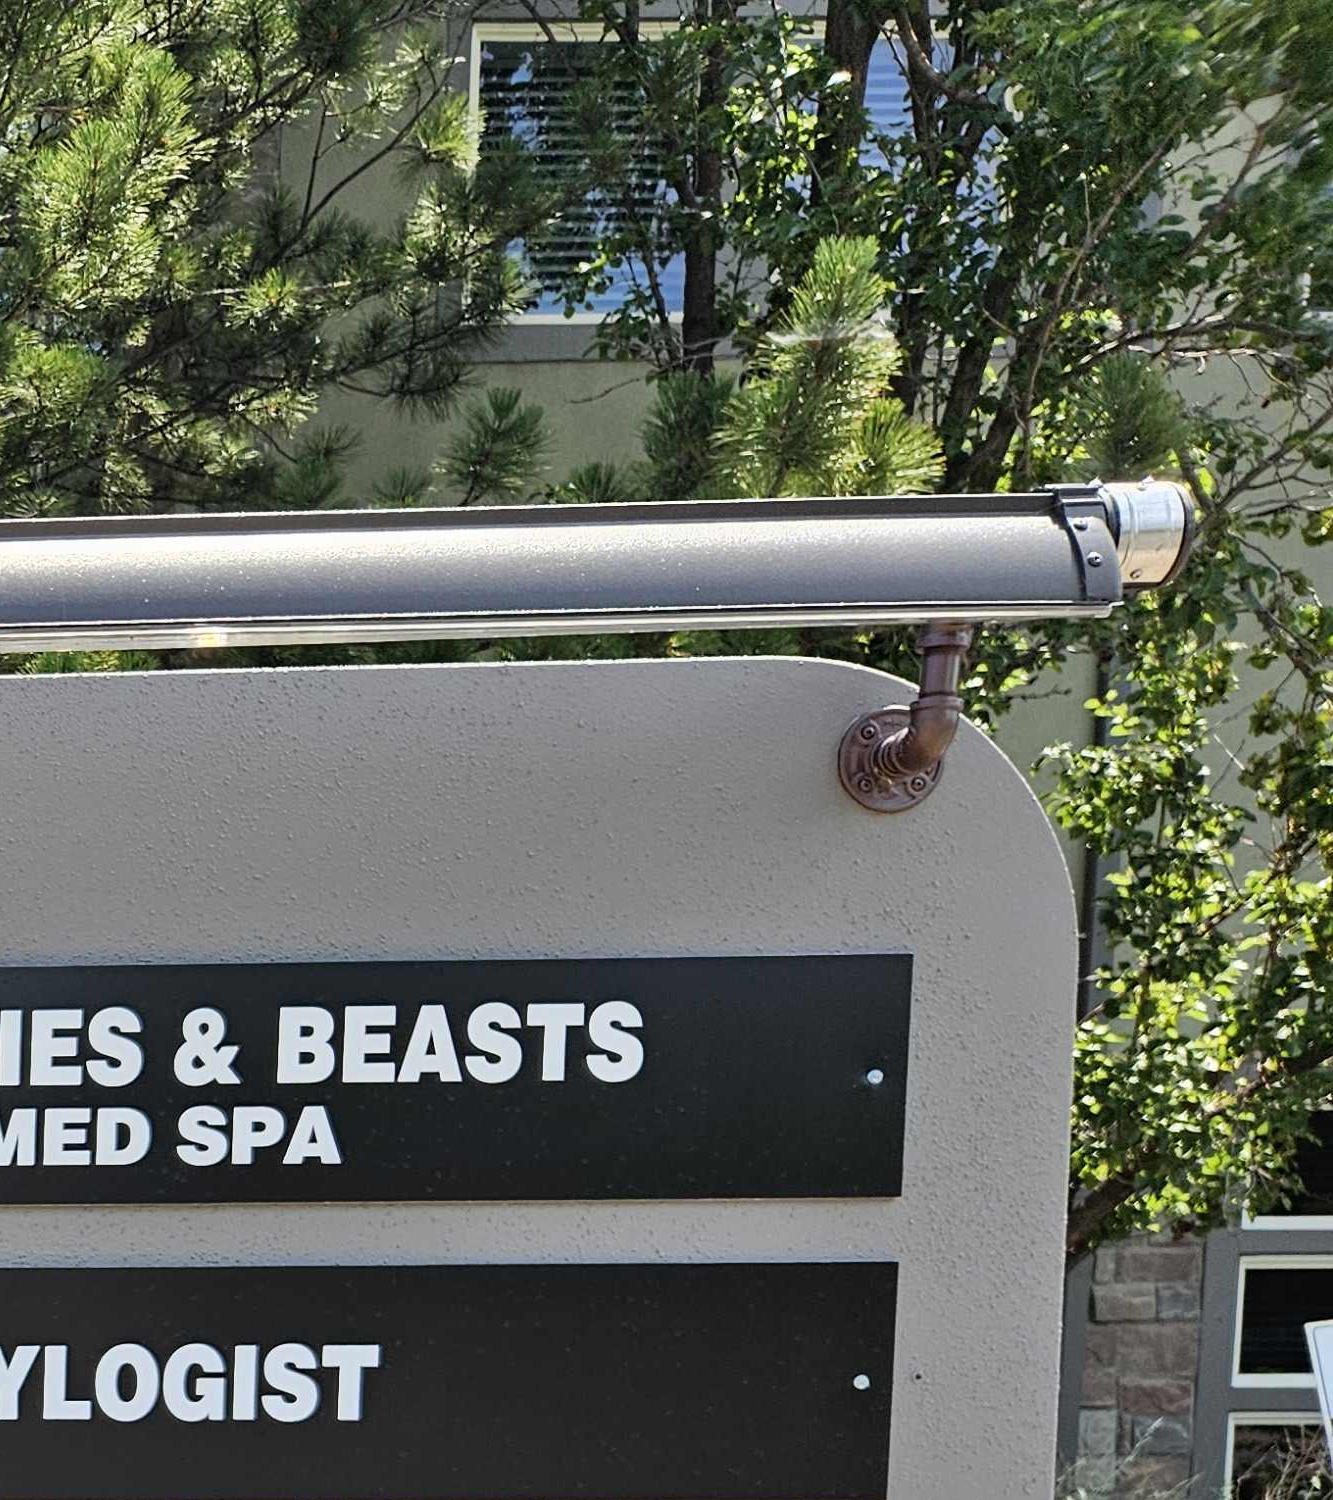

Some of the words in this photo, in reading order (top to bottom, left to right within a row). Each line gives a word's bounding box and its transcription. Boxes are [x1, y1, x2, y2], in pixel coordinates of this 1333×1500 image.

[174, 1008, 240, 1086] &
[277, 1001, 643, 1083] BEASTS
[176, 1106, 341, 1166] SPA
